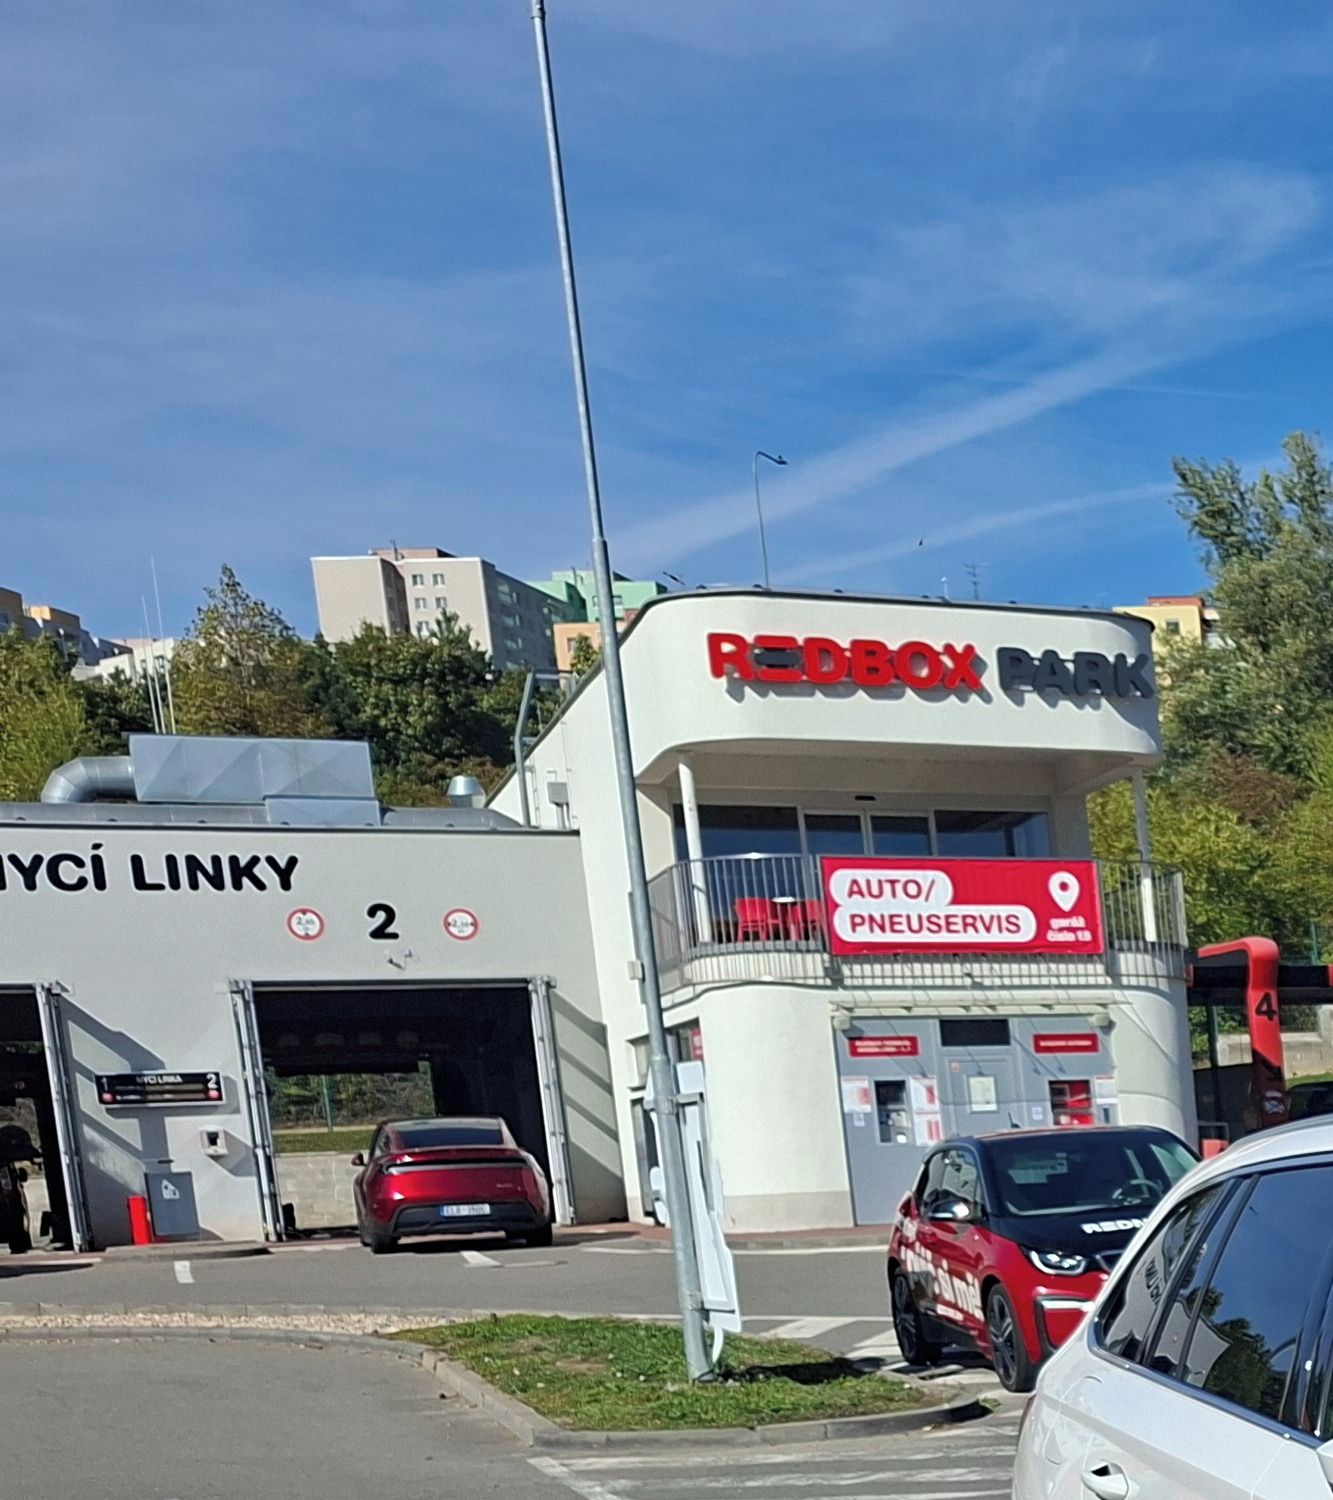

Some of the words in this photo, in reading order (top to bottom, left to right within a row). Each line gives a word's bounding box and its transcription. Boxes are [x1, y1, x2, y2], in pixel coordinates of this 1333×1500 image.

[707, 633, 981, 691] REDBOX
[997, 646, 1155, 699] PARK
[0, 843, 107, 891] YCÍ
[130, 854, 299, 891] LINKY
[847, 878, 936, 902] AUTO/
[366, 903, 400, 940] 2
[850, 913, 1022, 934] PNEUSERVIS
[1254, 991, 1278, 1021] 4
